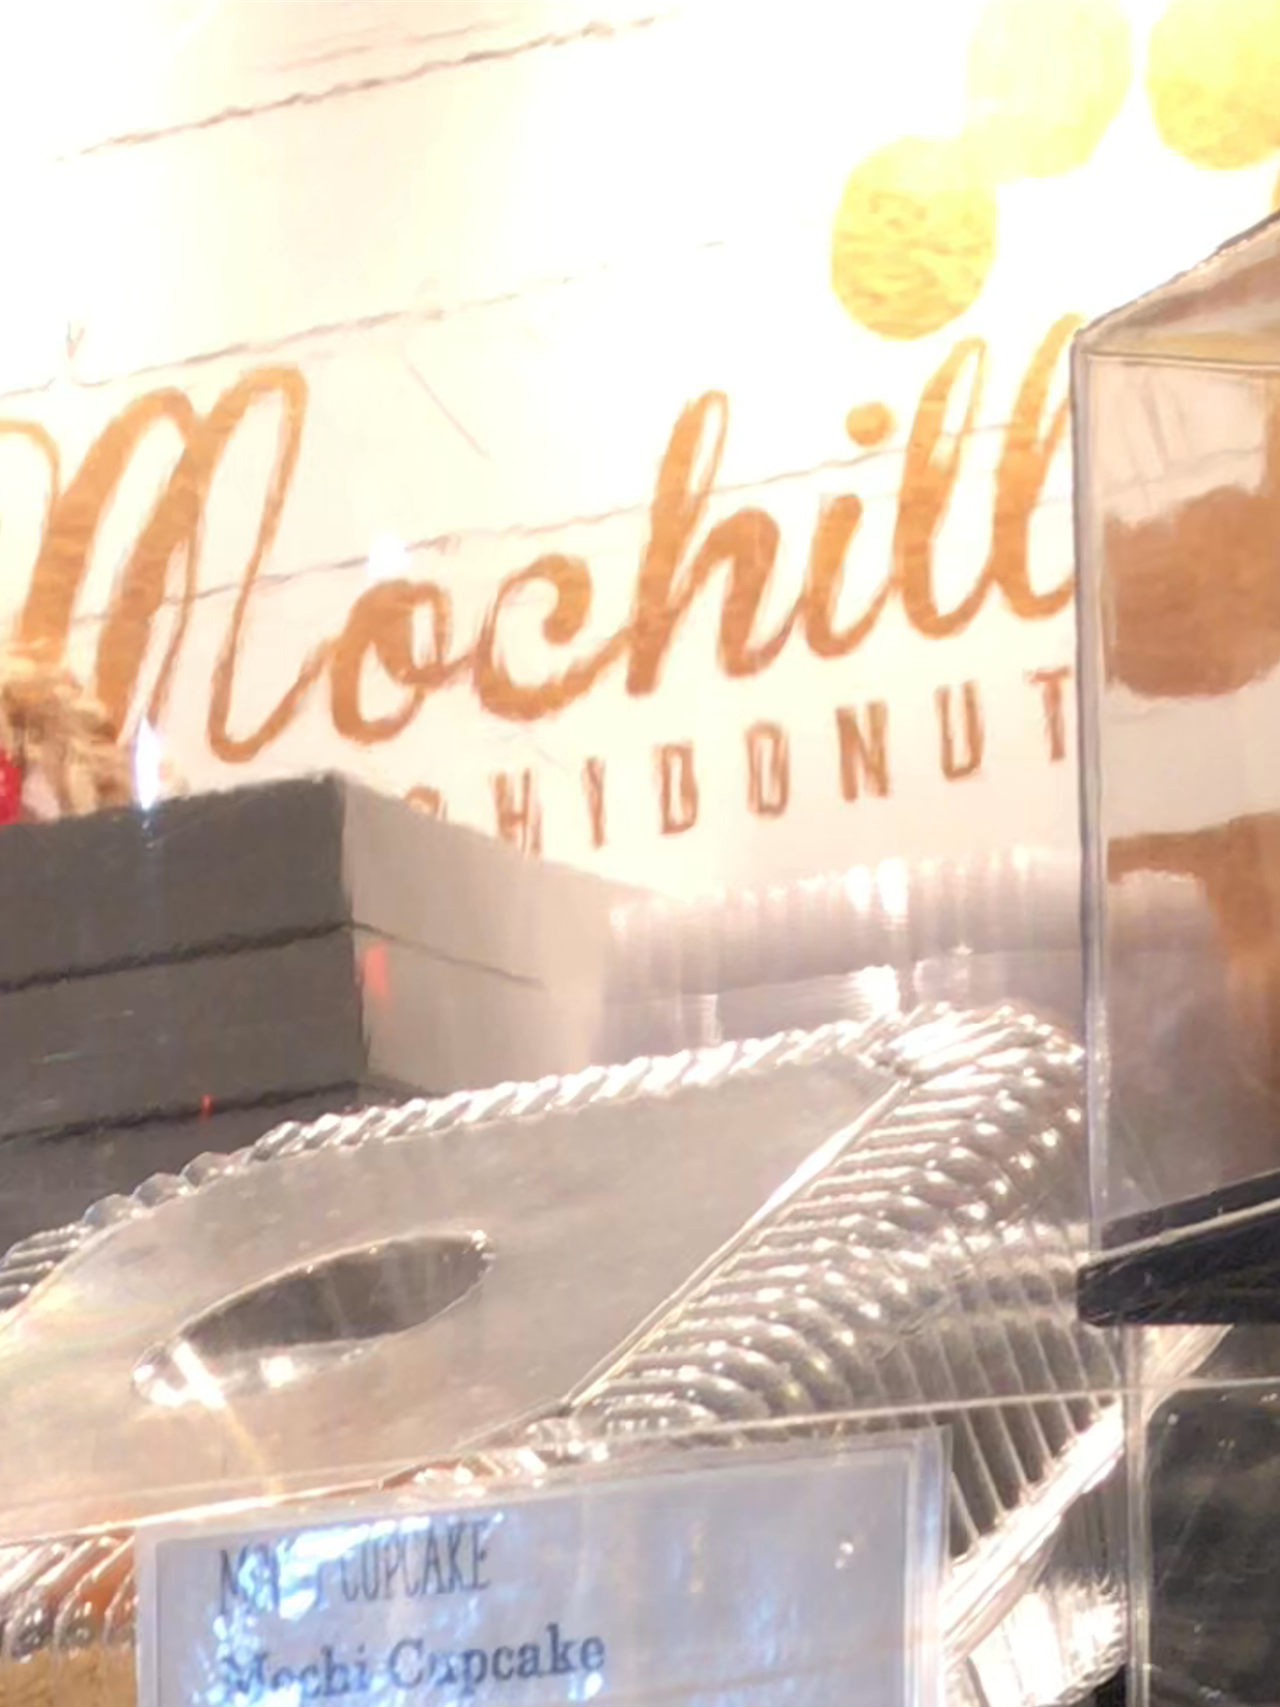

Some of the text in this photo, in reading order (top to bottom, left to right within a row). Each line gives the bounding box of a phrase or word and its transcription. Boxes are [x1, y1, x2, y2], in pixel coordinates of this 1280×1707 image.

[220, 1520, 492, 1615] MOCI CUPCAKE
[389, 1622, 606, 1704] Cupcake
